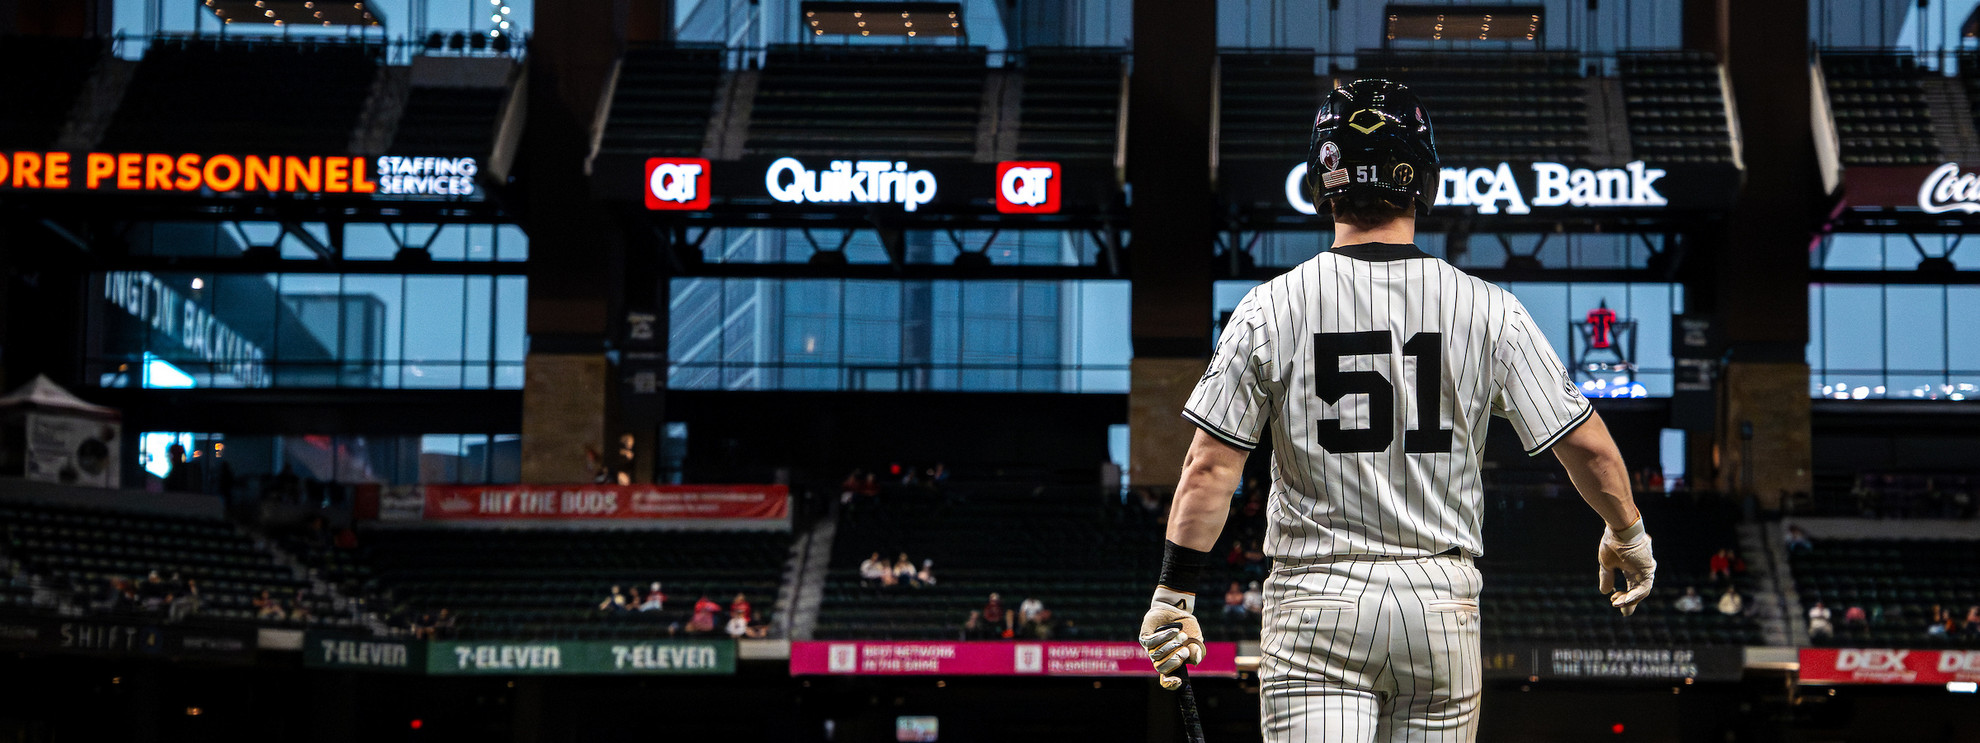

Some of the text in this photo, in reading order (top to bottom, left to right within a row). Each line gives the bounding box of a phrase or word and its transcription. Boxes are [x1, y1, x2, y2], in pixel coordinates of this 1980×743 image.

[0, 151, 376, 194] RE PERSONNEL
[377, 156, 478, 176] STAFFING
[380, 175, 475, 195] SERVICES
[650, 163, 702, 203] QT
[765, 157, 937, 212] QuikTrip
[1356, 165, 1378, 183] 51
[1531, 161, 1668, 207] Bank
[1001, 167, 1052, 207] QT
[1313, 330, 1453, 454] 51
[1835, 648, 1909, 671] DEX
